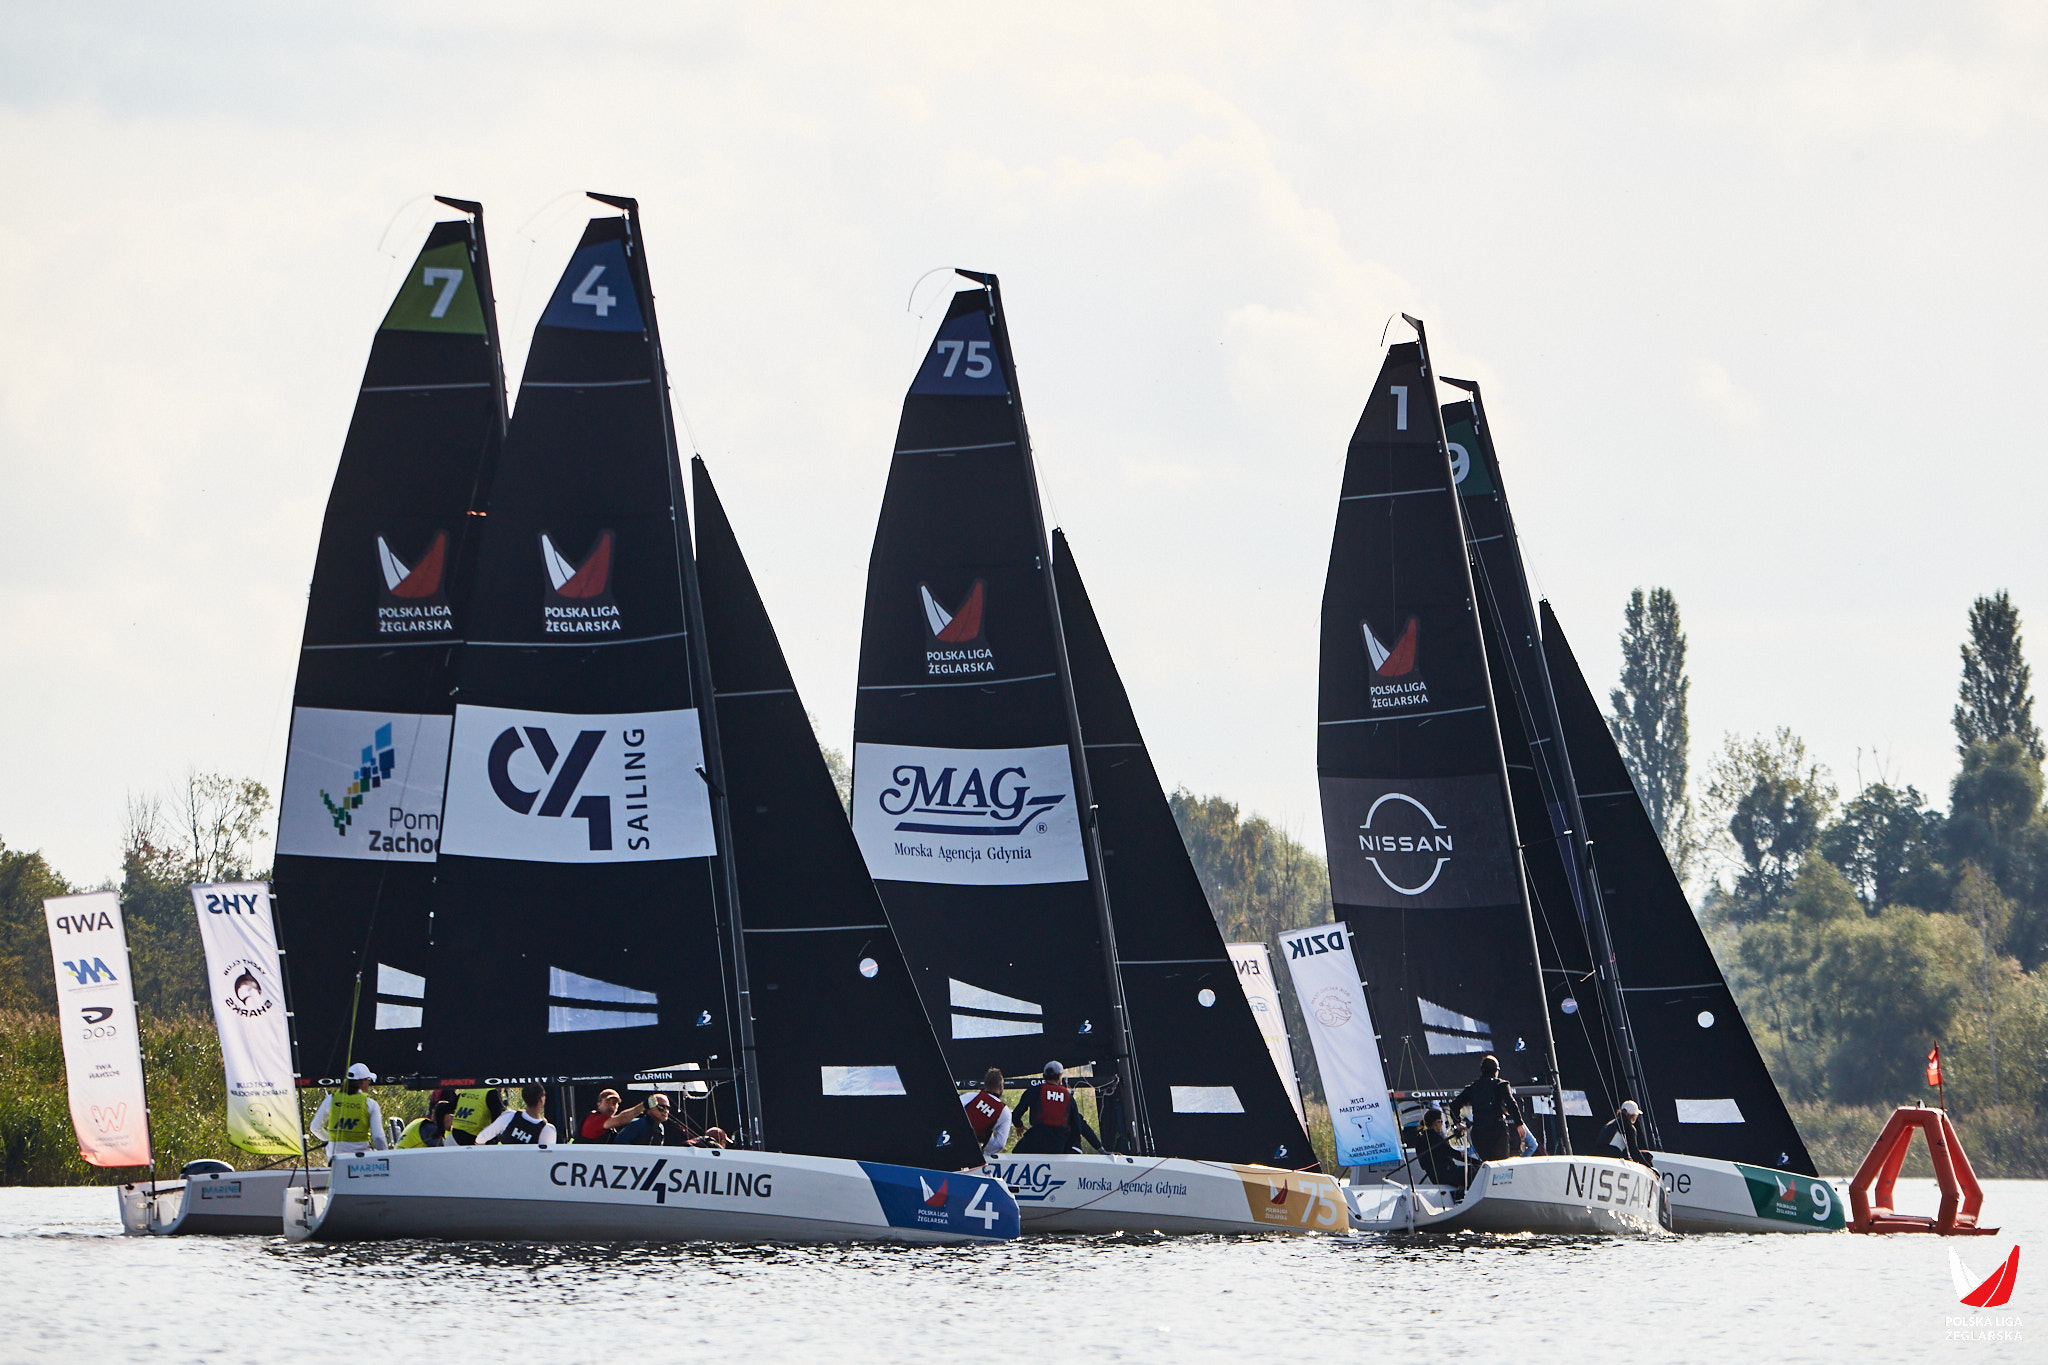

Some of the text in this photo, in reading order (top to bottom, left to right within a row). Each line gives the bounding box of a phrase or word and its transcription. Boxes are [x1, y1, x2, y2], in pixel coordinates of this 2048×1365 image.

[423, 267, 463, 318] 7
[571, 265, 616, 317] 4
[937, 340, 992, 378] 75
[1390, 385, 1408, 431] 1
[1447, 442, 1470, 485] 9
[378, 605, 451, 618] POLSKA LIGA
[544, 605, 620, 618] POLSKA LIGA
[379, 619, 453, 633] ŻEGLARSKA
[545, 619, 621, 633] ŻEGLARSKA
[926, 648, 993, 661] POLSKA LIGA
[928, 662, 995, 675] ŻEGLARSKA
[1370, 681, 1427, 696] POLSKA LIGA
[1372, 693, 1429, 708] ŻEGLARSKA
[623, 728, 650, 850] SAILING
[879, 765, 1031, 821] MAG
[1358, 834, 1453, 852] NISSAN
[894, 842, 1032, 863] Morska Agencja Gdynia
[633, 1072, 673, 1081] GARMIN
[1046, 1090, 1065, 1103] HH
[975, 1099, 995, 1118] HH
[511, 1127, 533, 1143] HH
[1077, 1177, 1187, 1198] Morska Agencja Gdynia
[1565, 1163, 1654, 1208] NISSAN
[964, 1183, 999, 1230] 4
[1298, 1180, 1337, 1226] 75
[1810, 1183, 1832, 1221] 9
[917, 1215, 948, 1224] ŻEGLARSKA
[918, 1209, 949, 1218] POLSKA LIGA
